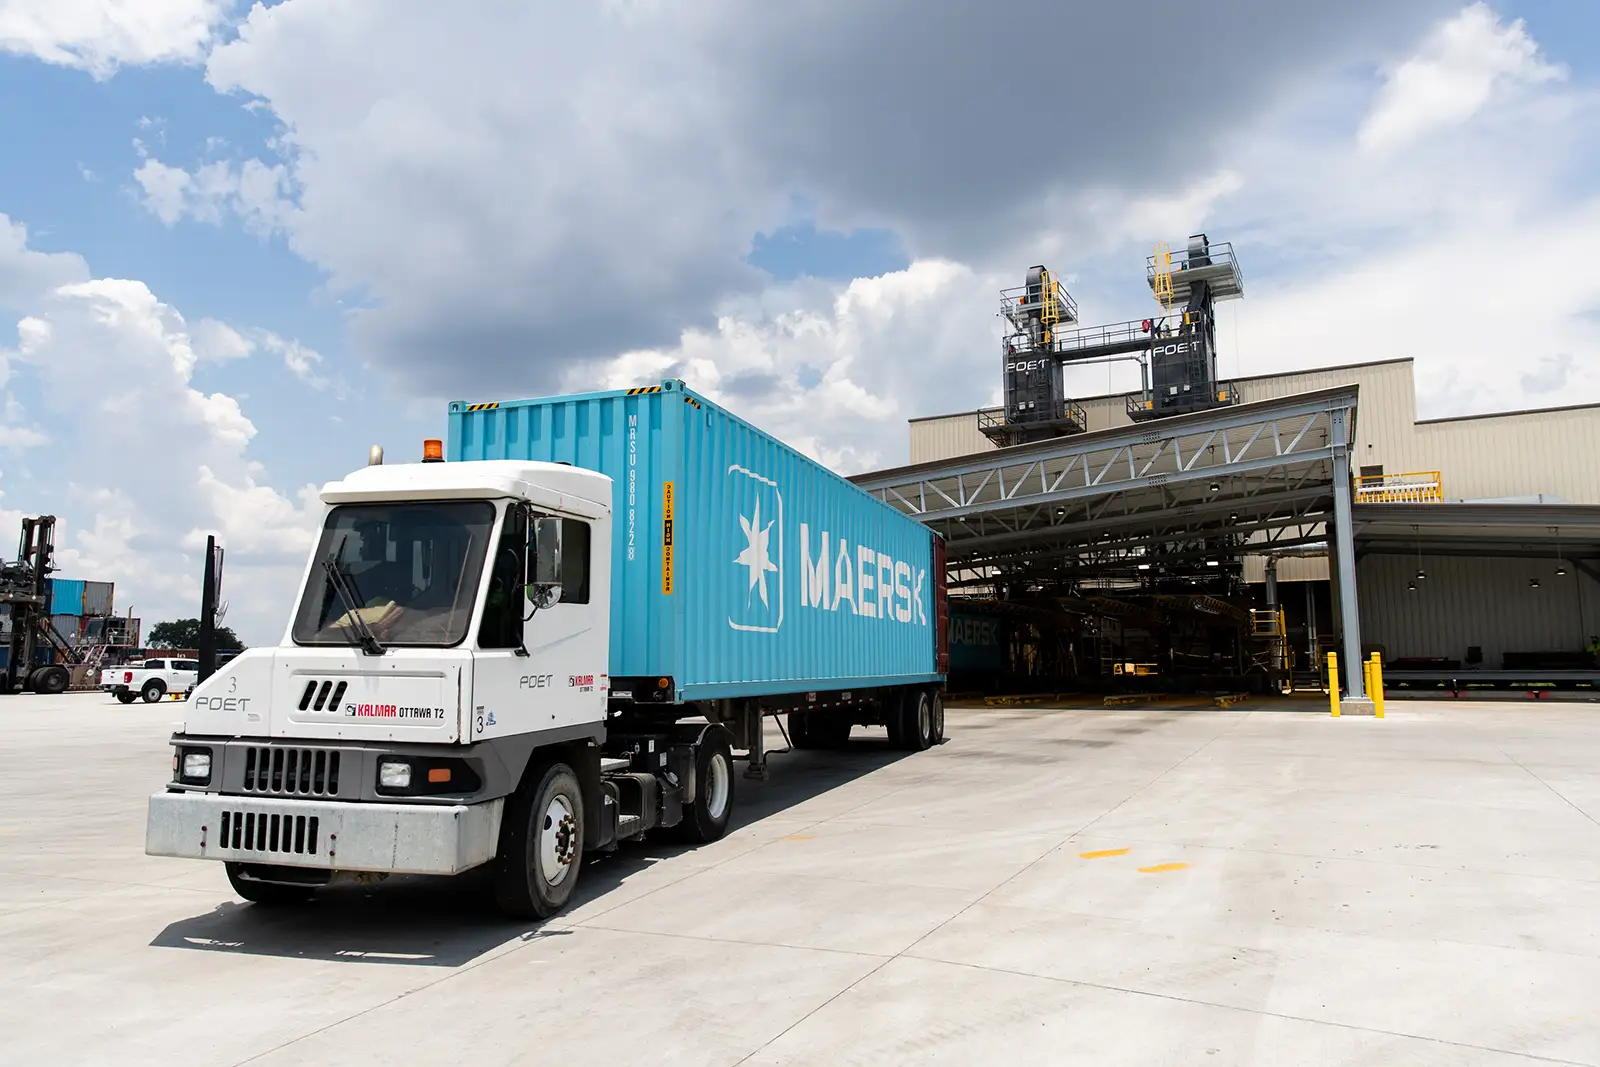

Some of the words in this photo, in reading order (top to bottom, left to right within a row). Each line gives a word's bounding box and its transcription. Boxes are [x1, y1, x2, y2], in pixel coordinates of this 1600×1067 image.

[1152, 340, 1202, 357] POET
[1005, 358, 1050, 372] POET
[628, 414, 637, 467] MRSU
[800, 523, 927, 626] MAERSK
[228, 676, 237, 693] 3
[520, 674, 554, 689] POET
[195, 697, 251, 712] POET
[357, 703, 397, 717] KALMAR
[399, 707, 432, 718] OTTAWA
[434, 708, 445, 719] T2
[476, 716, 484, 733] 3
